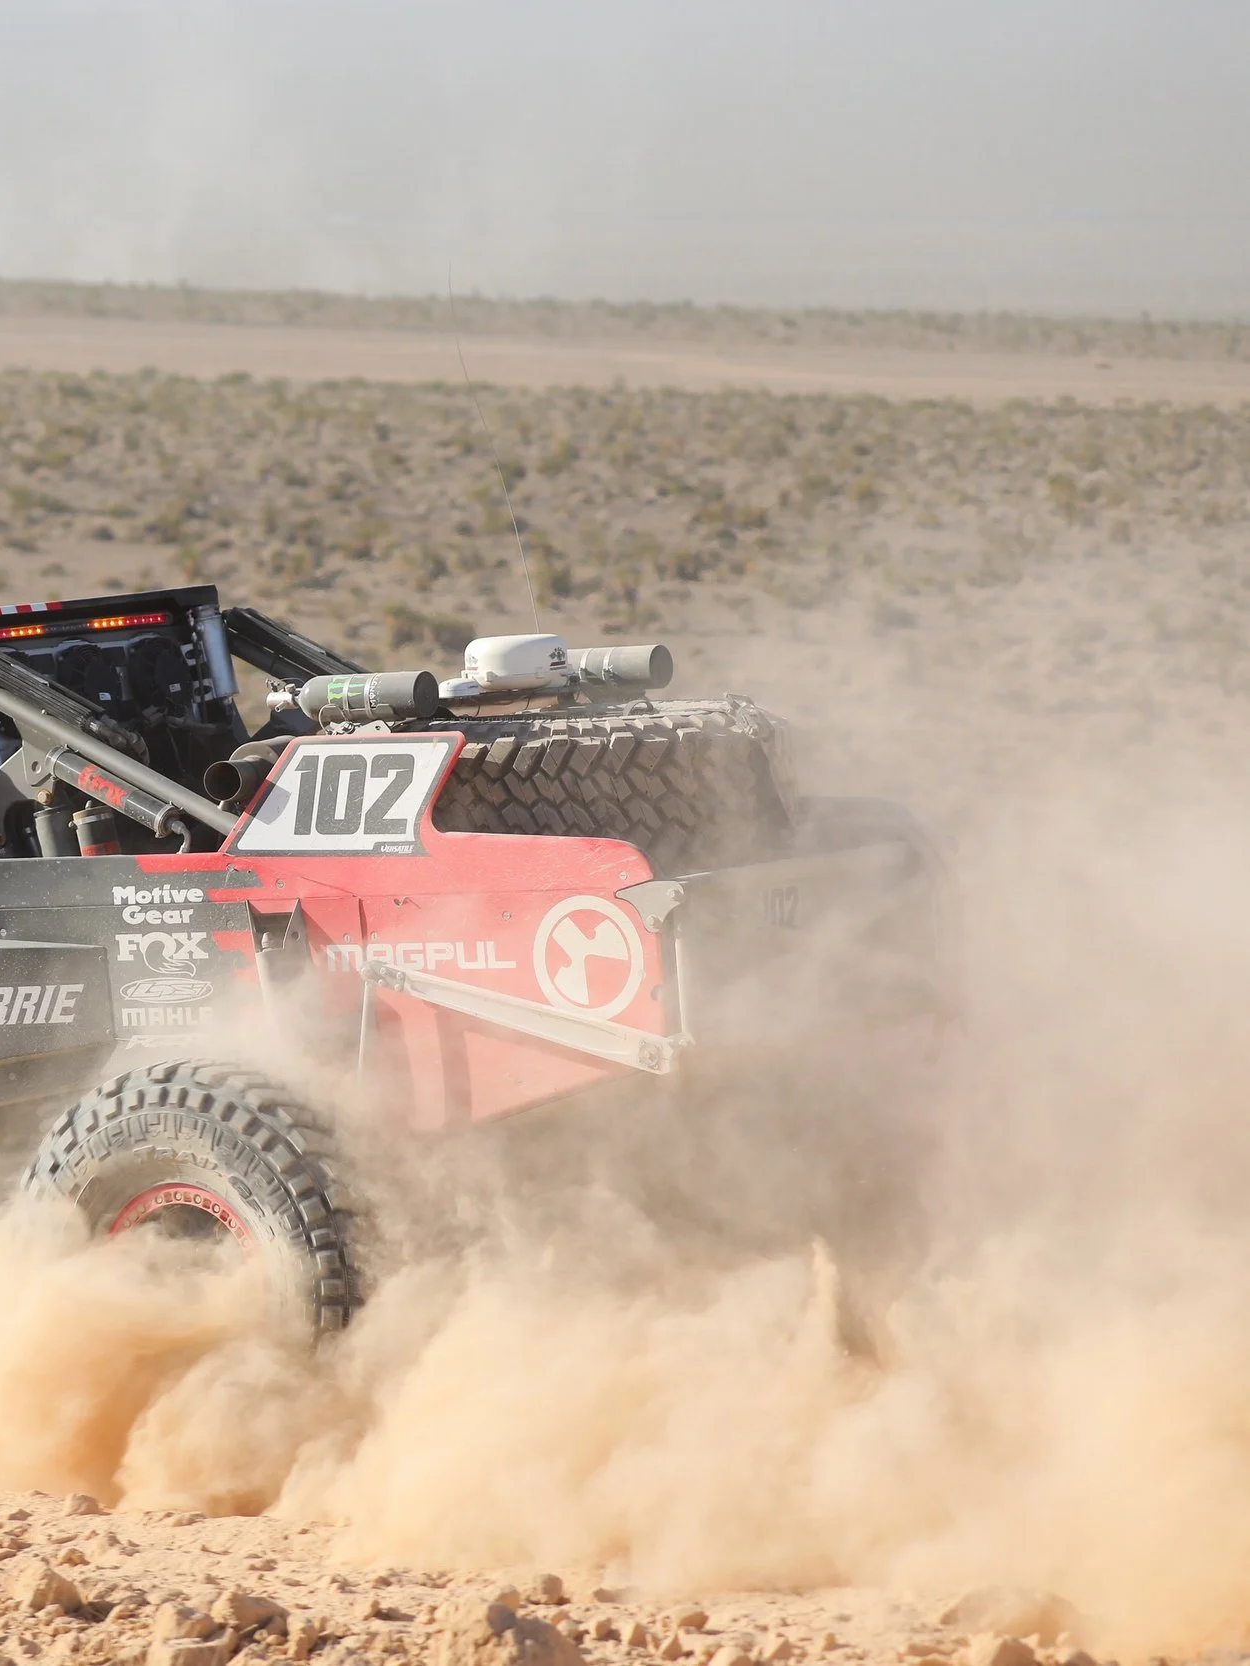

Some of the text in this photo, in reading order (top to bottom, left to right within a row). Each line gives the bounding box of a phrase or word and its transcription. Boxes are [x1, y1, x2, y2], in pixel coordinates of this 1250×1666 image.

[292, 753, 414, 836] 102
[112, 884, 204, 906] Motive
[122, 906, 194, 925] Gear
[115, 931, 209, 966] FOX
[326, 940, 517, 972] MAGPUL
